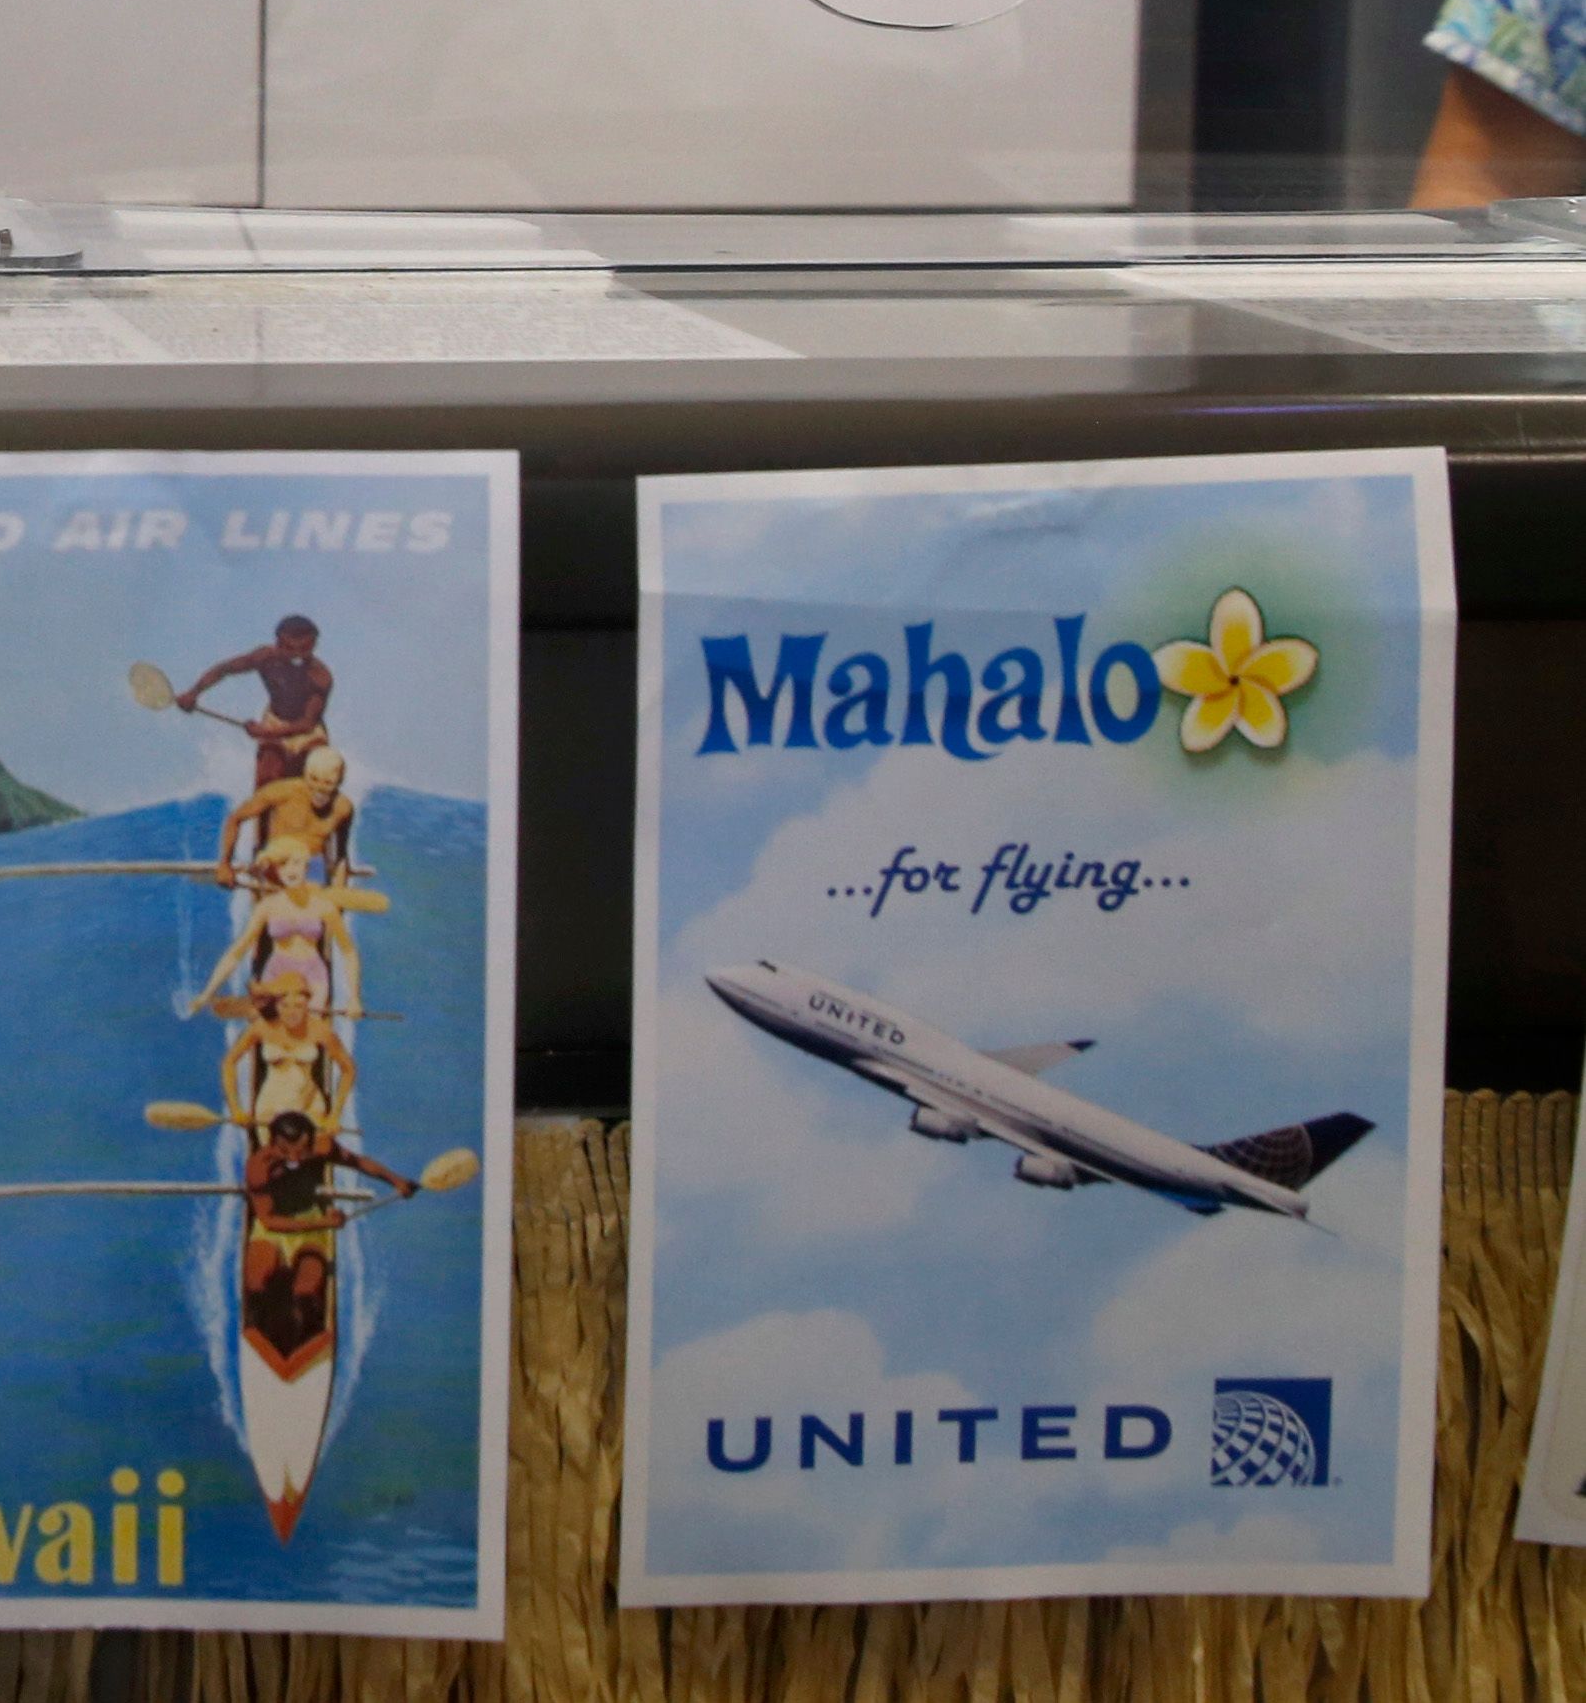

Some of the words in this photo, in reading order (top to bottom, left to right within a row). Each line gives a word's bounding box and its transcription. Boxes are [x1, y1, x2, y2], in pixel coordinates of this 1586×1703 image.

[53, 509, 189, 551] AIR
[221, 510, 453, 554] LINES
[696, 613, 1161, 761] Mahalo
[828, 846, 961, 917] ...for
[971, 843, 1192, 914] flying...
[809, 995, 906, 1045] UNITED
[707, 1404, 1173, 1474] UNITED
